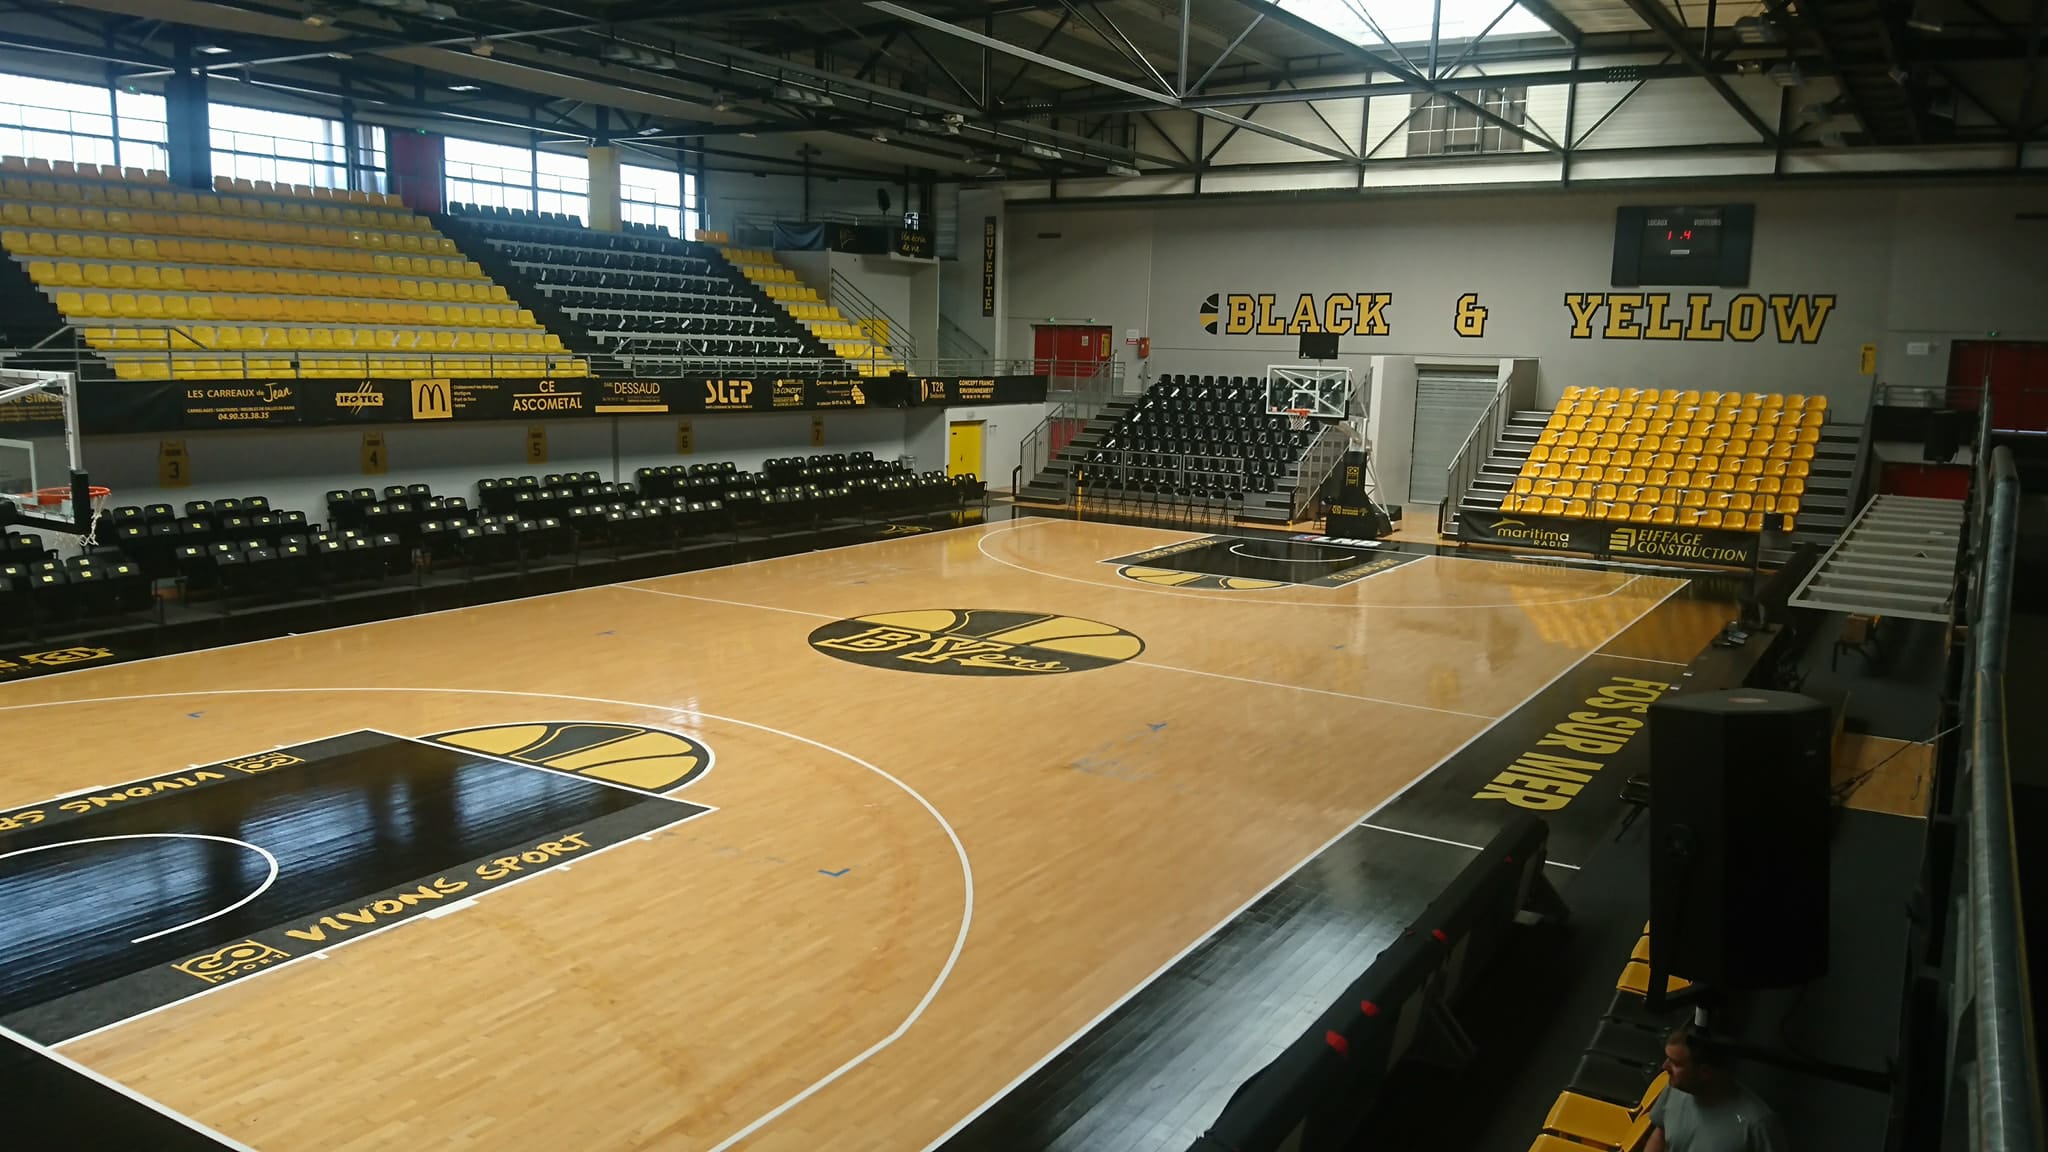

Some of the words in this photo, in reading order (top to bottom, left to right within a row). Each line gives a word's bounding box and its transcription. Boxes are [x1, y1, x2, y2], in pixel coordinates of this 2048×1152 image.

[983, 224, 995, 310] BUVETTE
[1225, 292, 1393, 336] BLACK
[1454, 293, 1488, 337] &
[1564, 292, 1837, 343] YELLOW
[187, 390, 203, 398] LES
[207, 389, 255, 398] CARREAUX
[263, 382, 293, 403] Jean
[539, 381, 555, 393] CE
[614, 382, 660, 395] DESSAUD
[931, 381, 944, 393] T2R
[513, 397, 582, 411] ASCOMETAL
[533, 442, 541, 456] 5
[682, 435, 688, 449] 6
[370, 450, 379, 467] 4
[168, 461, 179, 479] 3
[1497, 527, 1569, 542] maritima
[1638, 529, 1703, 545] EIFFAGE
[1533, 540, 1569, 548] RADIO
[1637, 541, 1748, 562] CONSTRUCTION
[1585, 676, 1670, 713] FOS
[1536, 711, 1644, 754] SUR
[1472, 752, 1604, 811] MER
[59, 771, 226, 814] VIVONS
[284, 876, 469, 942] VIVONS
[475, 832, 593, 882] SPORT
